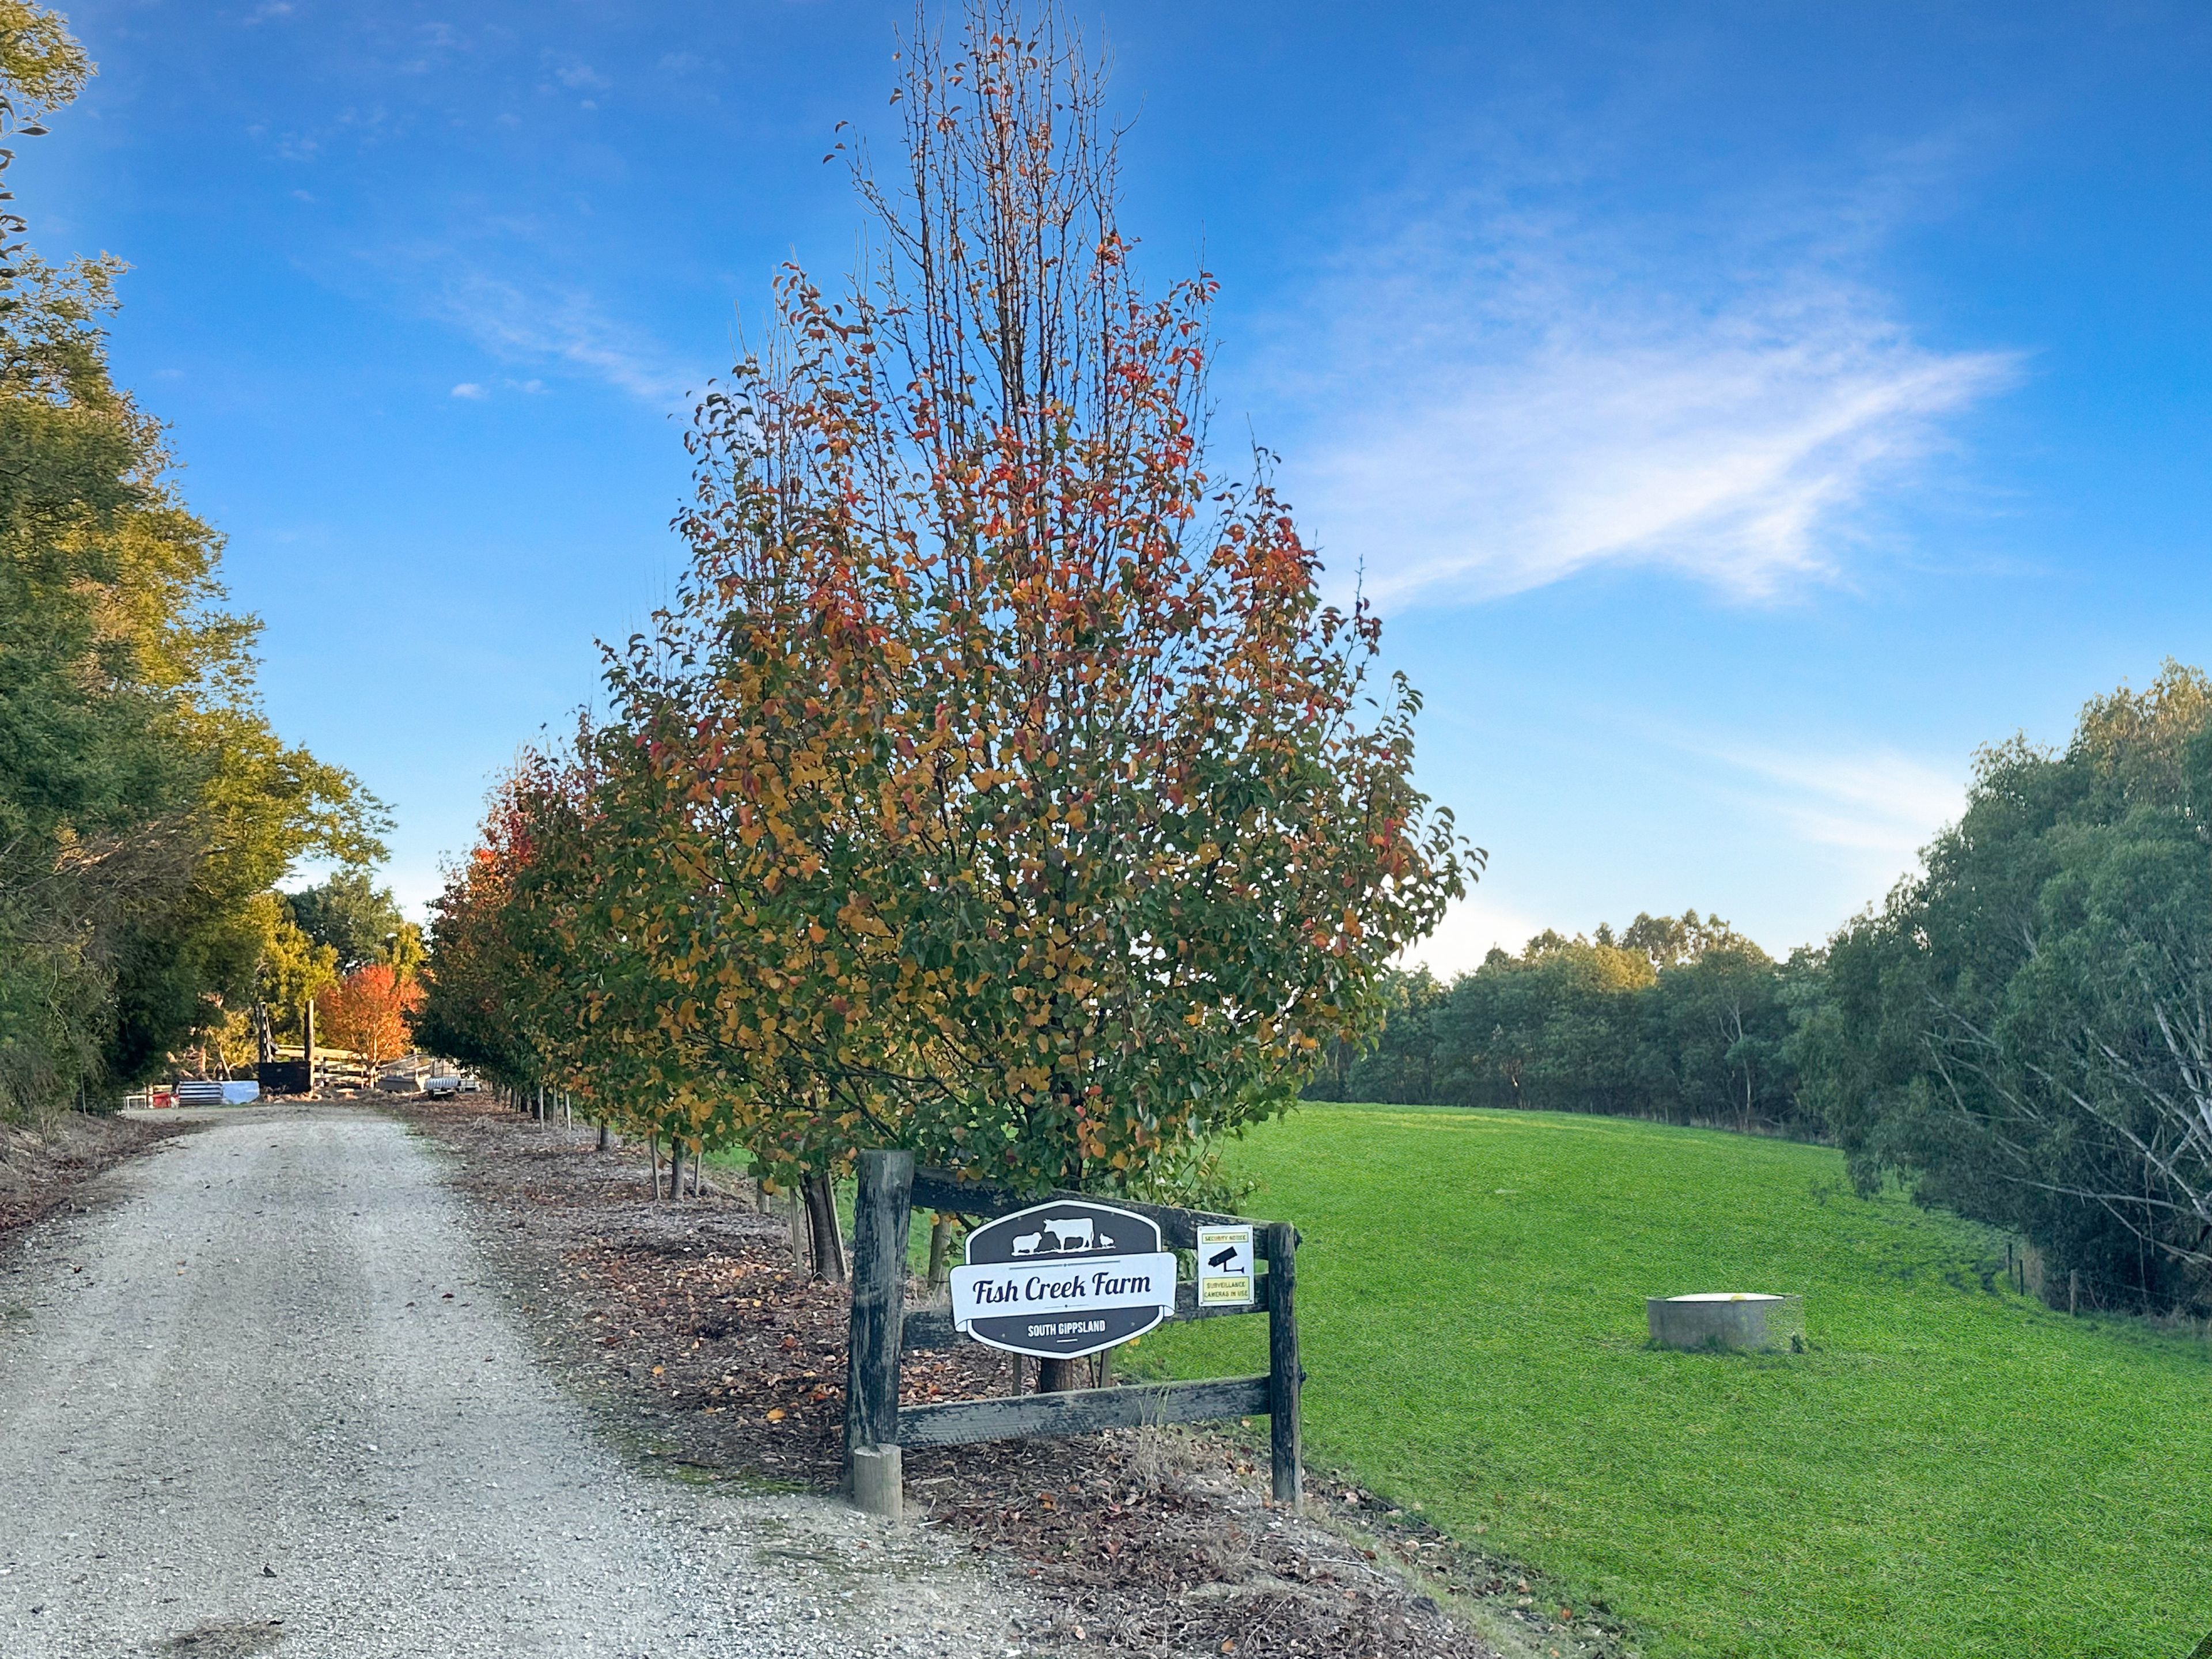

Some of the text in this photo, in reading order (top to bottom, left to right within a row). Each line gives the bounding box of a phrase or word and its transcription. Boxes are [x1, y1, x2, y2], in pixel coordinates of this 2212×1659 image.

[973, 1272, 1151, 1304] Fish Creek Farm
[1028, 1320, 1105, 1337] SOUTH GIPPSLAND
